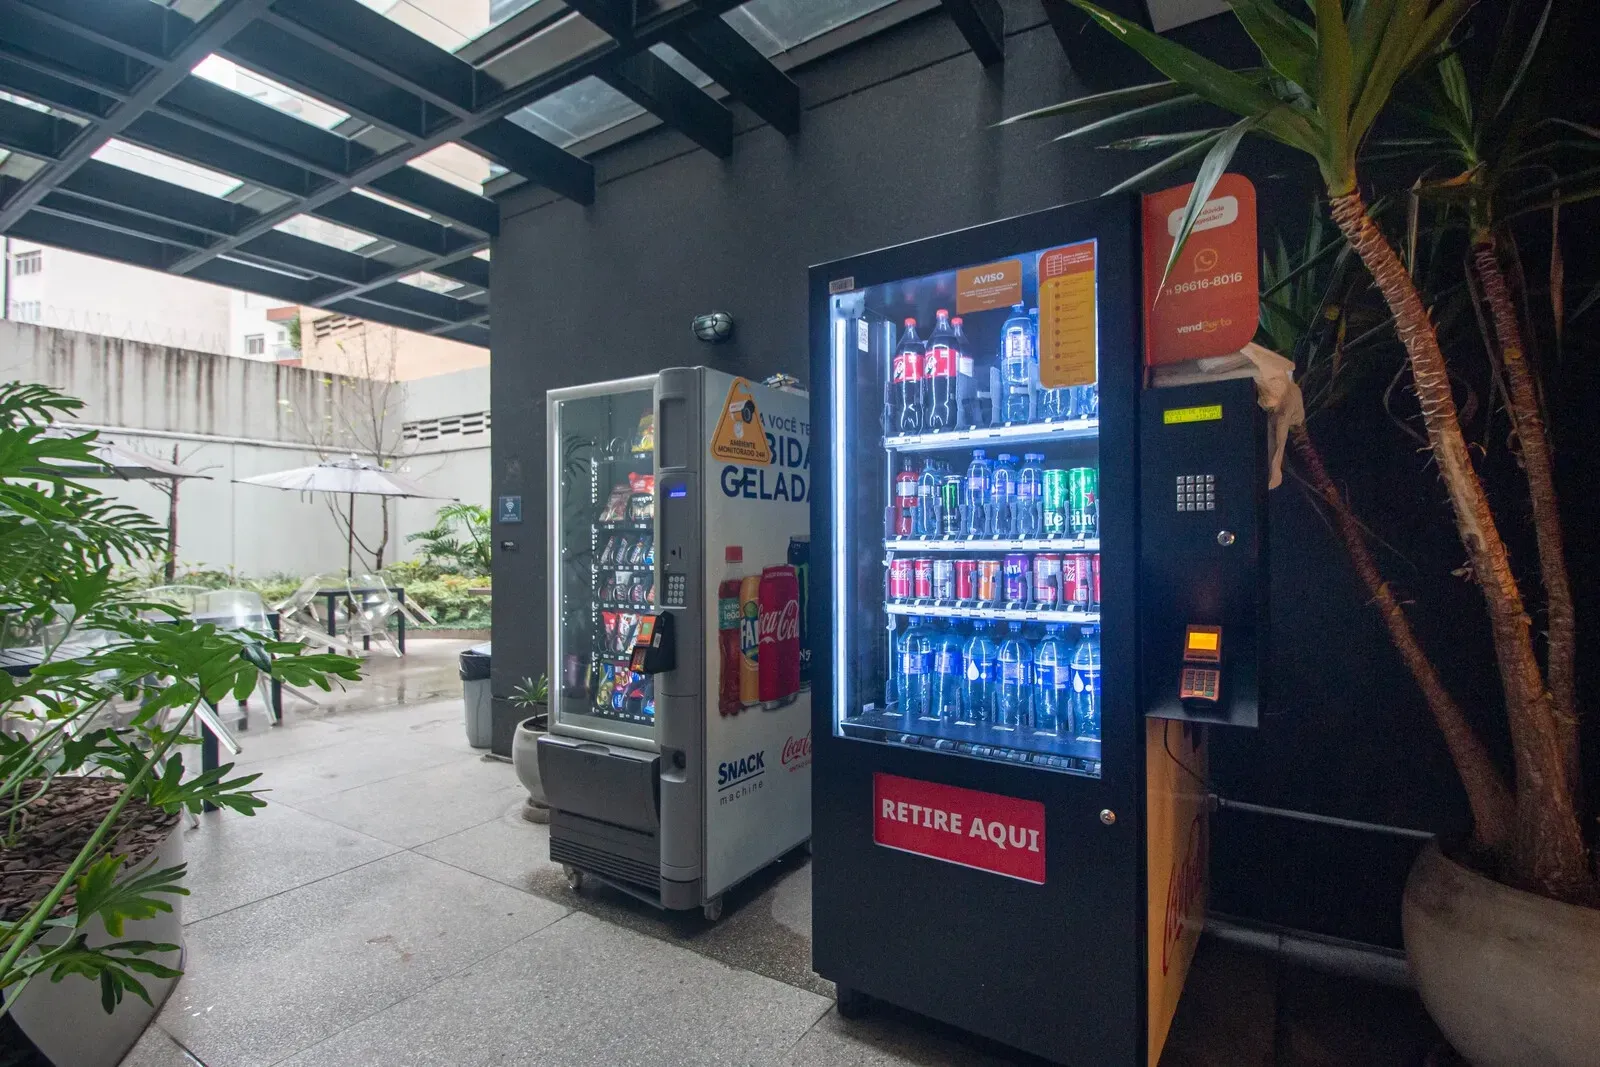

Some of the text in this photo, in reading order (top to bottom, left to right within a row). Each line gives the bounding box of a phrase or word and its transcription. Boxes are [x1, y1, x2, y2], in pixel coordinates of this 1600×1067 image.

[973, 272, 1005, 285] AVISO
[1174, 272, 1243, 294] 96616-8016
[768, 414, 797, 434] VOCÊ
[800, 422, 811, 436] TE
[718, 445, 755, 457] MONITORADO
[765, 432, 811, 470] BID
[720, 465, 811, 503] GELAD
[717, 750, 765, 786] SNACK
[719, 780, 764, 806] machine
[882, 798, 1040, 852] RETIRE AQUI
